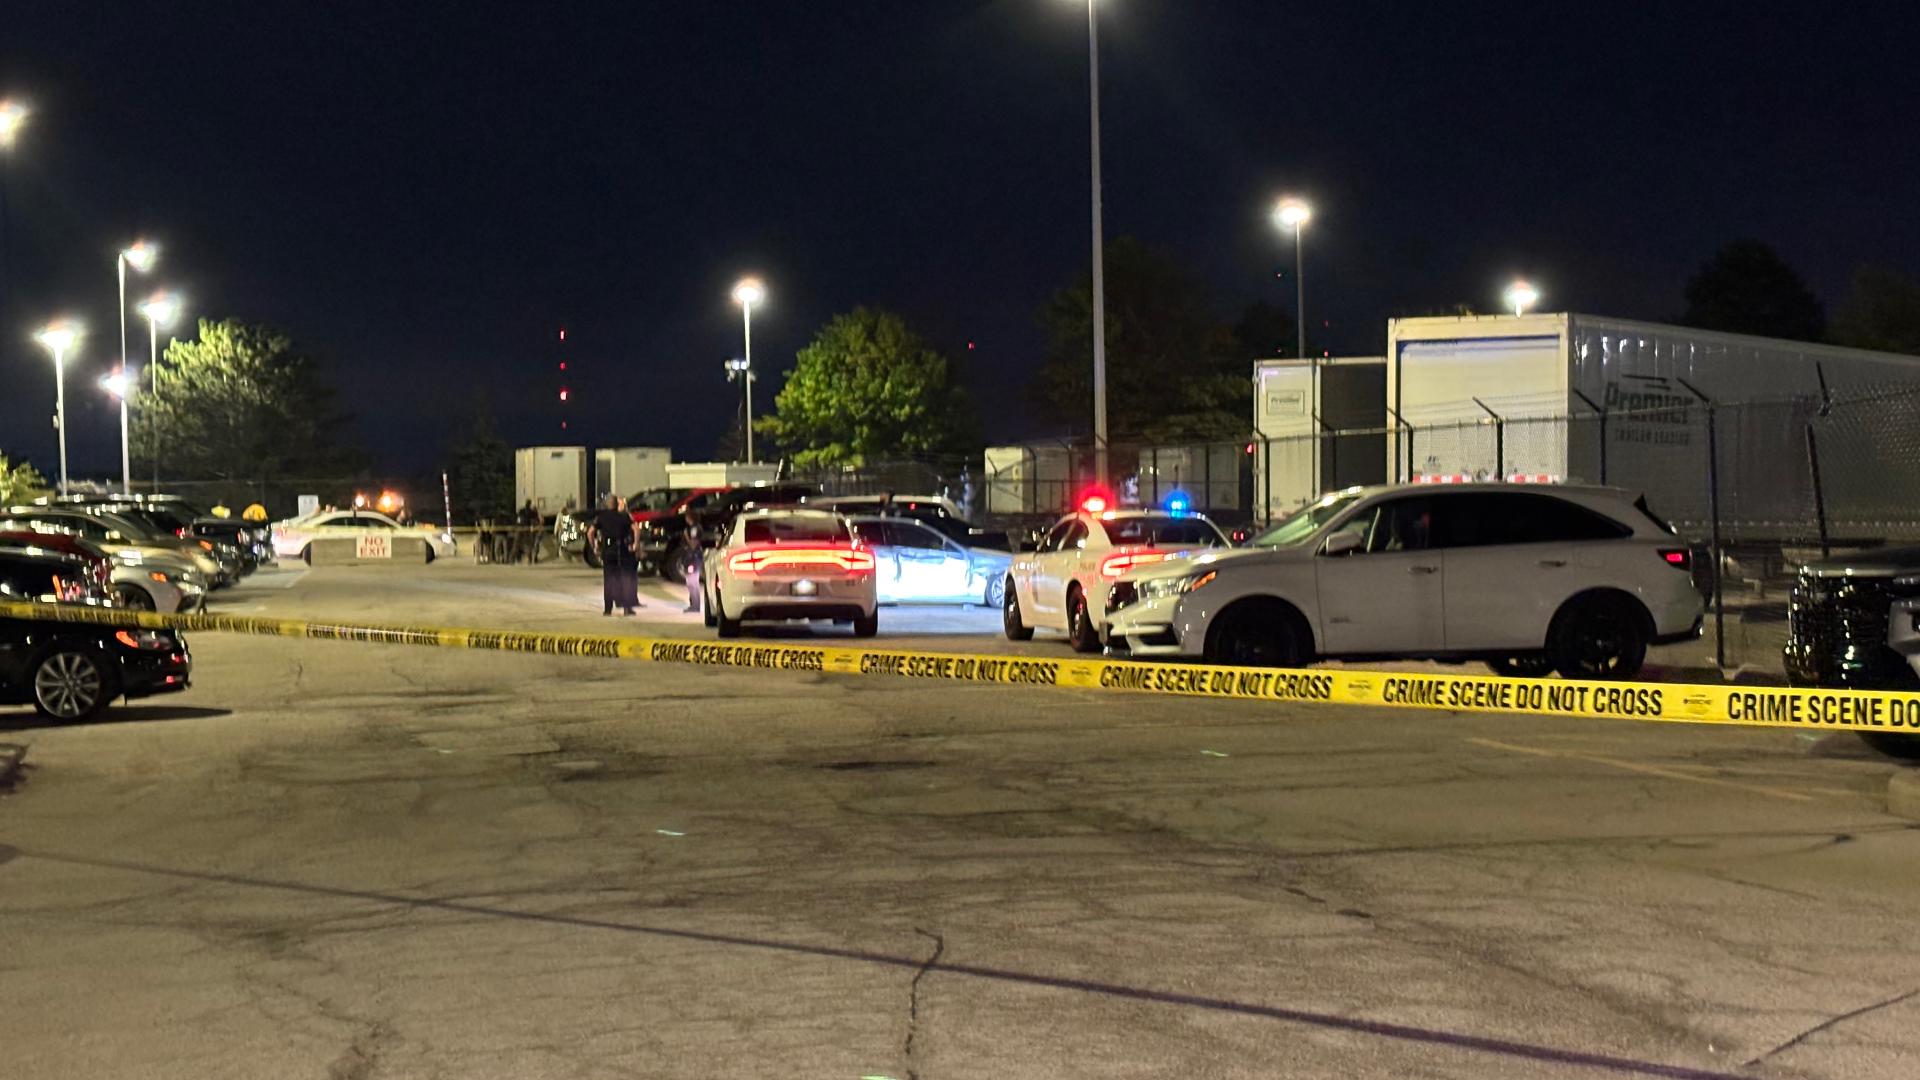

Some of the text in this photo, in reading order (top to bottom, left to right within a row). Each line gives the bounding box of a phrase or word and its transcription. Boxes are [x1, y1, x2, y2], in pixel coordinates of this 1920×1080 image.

[1606, 382, 1694, 425] Premier
[360, 547, 386, 557] EXIT
[365, 536, 383, 546] NO
[467, 631, 619, 658] CRIME SCENE DO NOT CROSS
[651, 642, 824, 671] CRIME SCENE DO NOT CROSS
[860, 653, 905, 675] CRIME
[907, 656, 953, 677] SCENE
[955, 658, 975, 679] DO
[977, 659, 1007, 681] NOT
[1008, 661, 1059, 684] CROSS
[1100, 665, 1153, 688] CRIME
[1154, 668, 1208, 691] SCENE
[1211, 671, 1234, 693] DO
[1237, 672, 1272, 696] NOT
[1274, 673, 1333, 698] CROSS
[1383, 679, 1445, 705] CRIME
[1448, 681, 1511, 708] SCENE
[1516, 684, 1543, 710] DO
[1548, 685, 1588, 712] NOT
[1592, 687, 1662, 715] CROSS
[1728, 693, 1801, 722] CRIME
[1808, 695, 1883, 726] SCENE
[1891, 698, 1920, 728] DO
